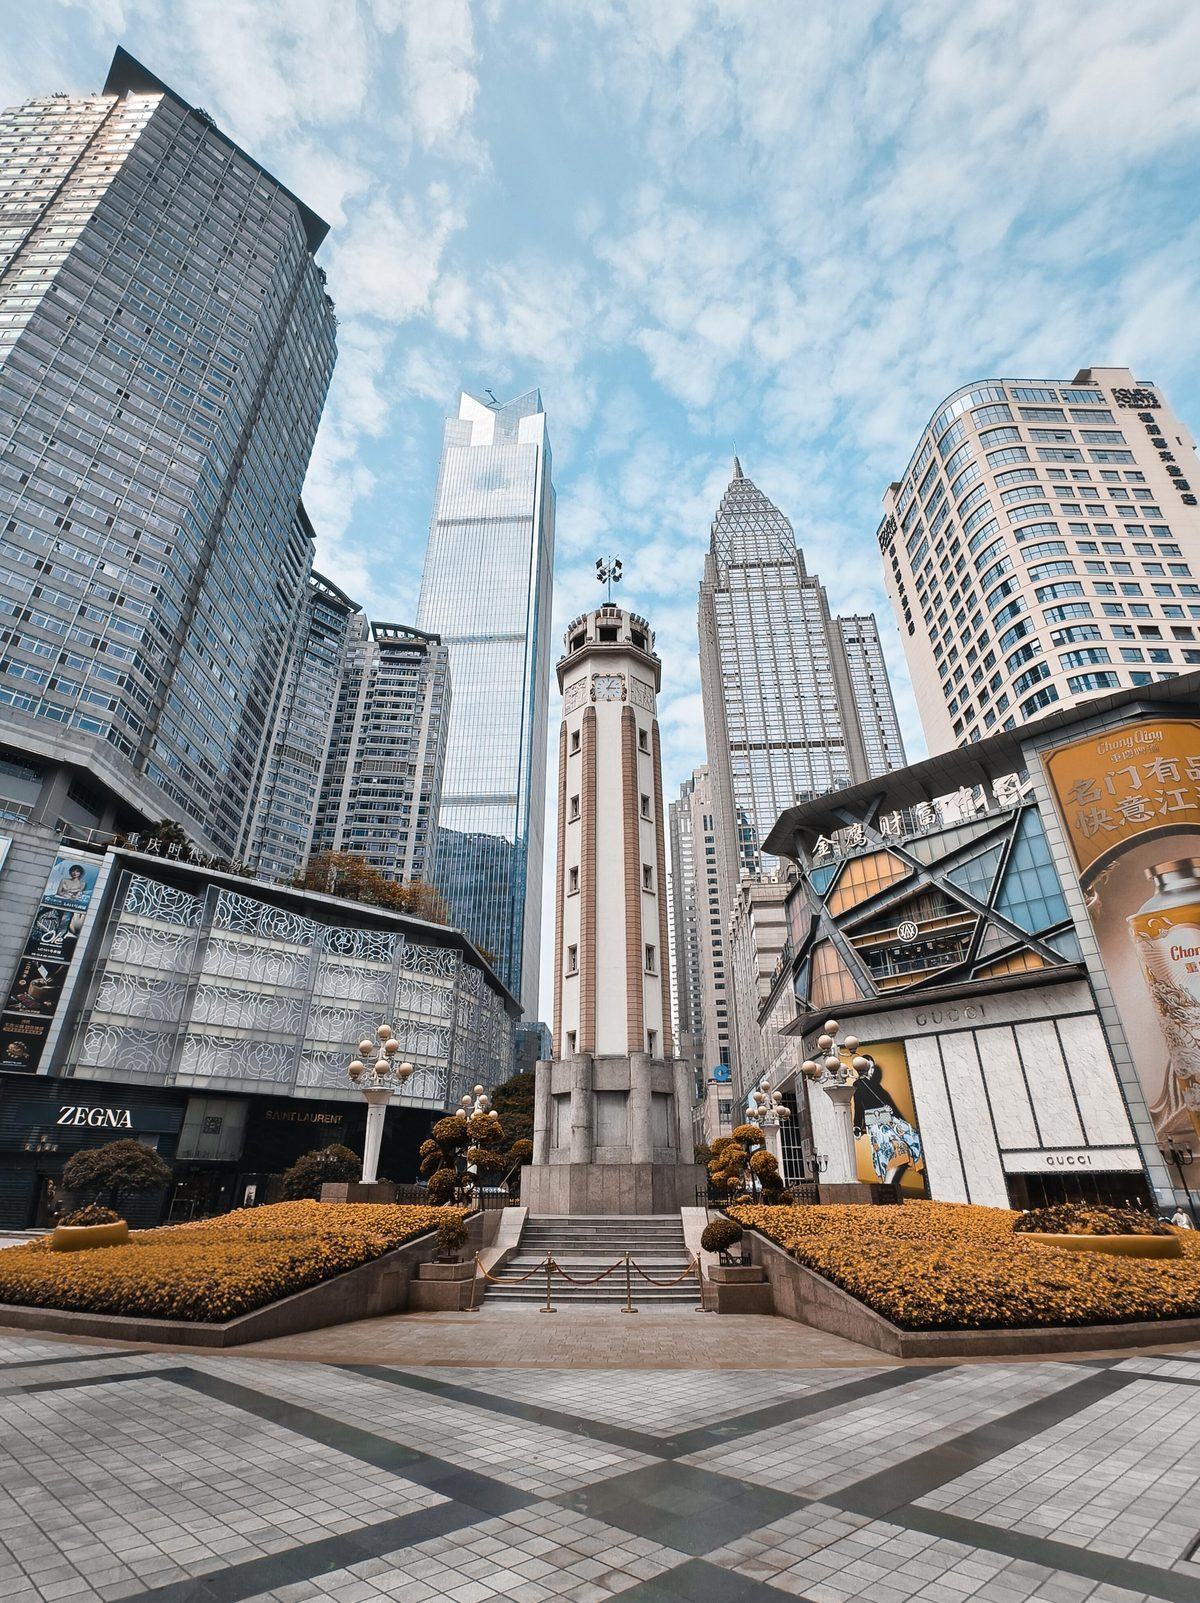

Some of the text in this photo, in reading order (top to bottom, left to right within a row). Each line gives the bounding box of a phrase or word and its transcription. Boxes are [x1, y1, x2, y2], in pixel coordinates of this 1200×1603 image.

[1075, 785, 1200, 839] 快意江
[915, 1004, 986, 1027] GUCCI
[56, 1106, 133, 1128] ZEGNA
[265, 1110, 344, 1125] SAINT LAURENT
[1046, 1155, 1092, 1166] GUCCI
